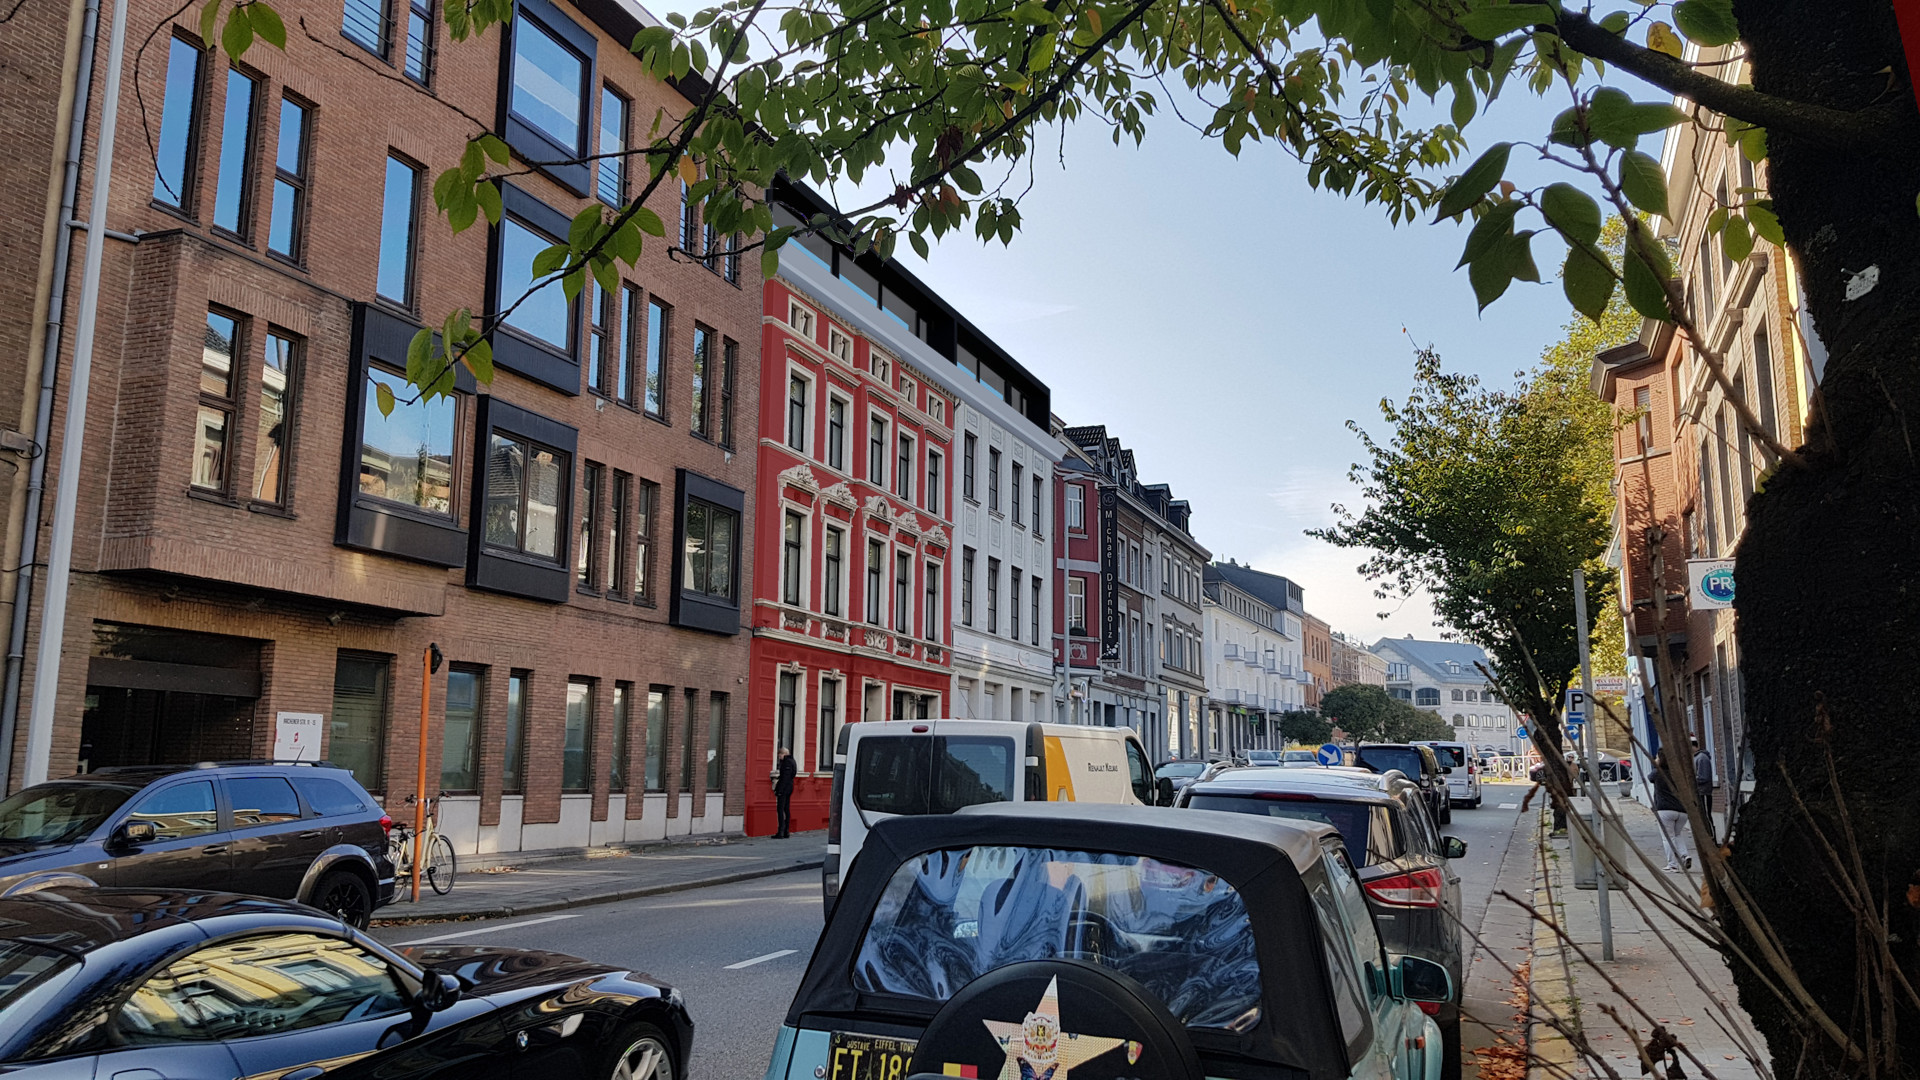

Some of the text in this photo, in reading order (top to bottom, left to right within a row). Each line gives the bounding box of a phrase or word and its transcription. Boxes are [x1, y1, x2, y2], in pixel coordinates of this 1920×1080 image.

[1105, 510, 1113, 568] Michael
[1571, 693, 1583, 711] P
[874, 1039, 896, 1051] EIFFEL
[880, 1053, 912, 1080] 18
